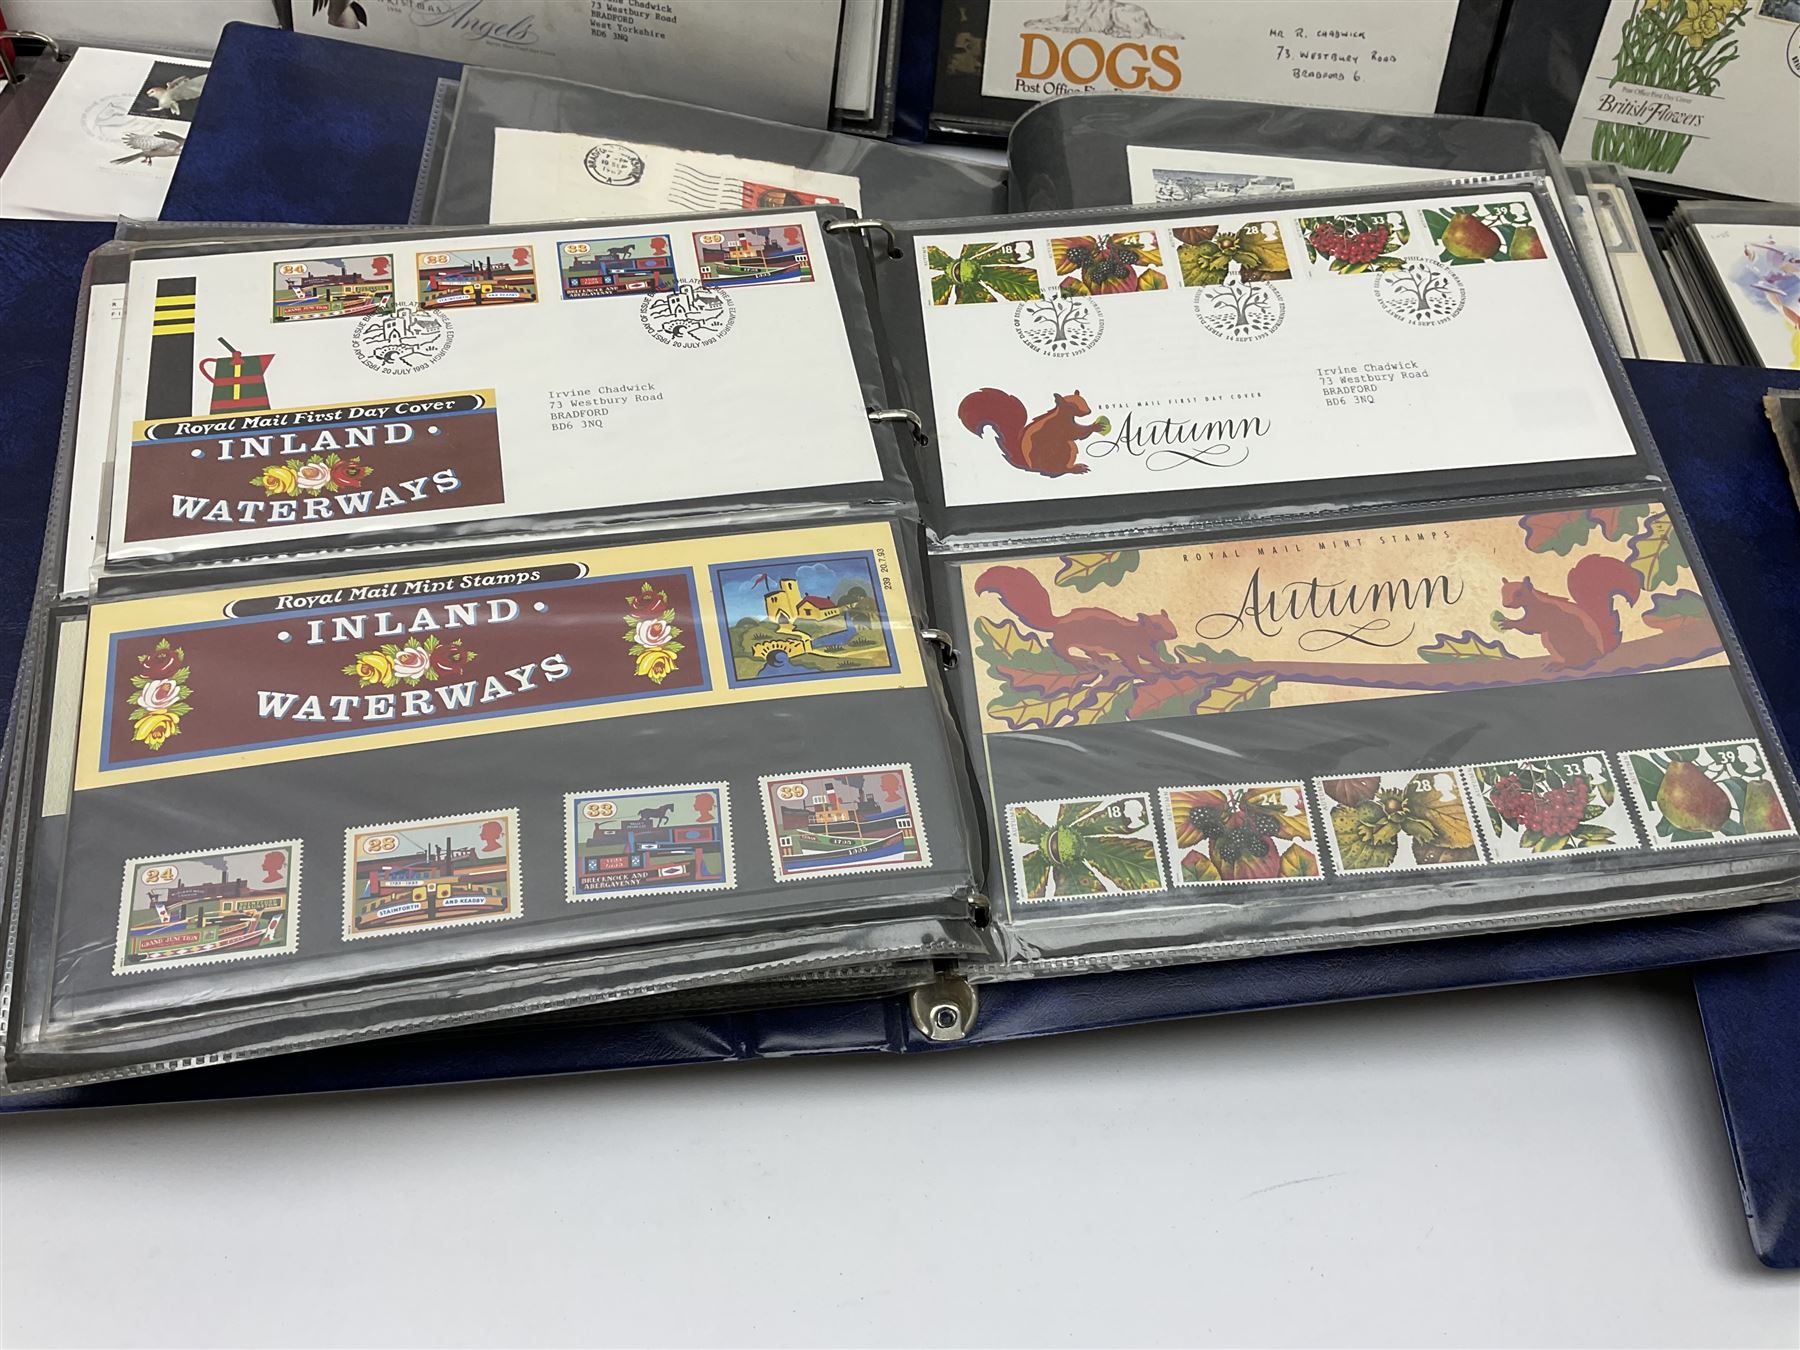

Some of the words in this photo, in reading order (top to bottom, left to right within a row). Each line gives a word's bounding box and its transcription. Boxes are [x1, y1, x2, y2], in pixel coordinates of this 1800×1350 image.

[591, 10, 634, 24] BRADFORD
[592, 1, 602, 9] 73
[606, 3, 650, 19] Westbury
[655, 13, 677, 24] Road
[590, 19, 612, 30] West
[617, 23, 666, 39] Yorkshire
[1016, 32, 1182, 93] DOGS
[1014, 78, 1041, 93] Post
[1597, 93, 1649, 118] British
[1638, 102, 1705, 127] Flowers
[1494, 206, 1508, 216] 39
[1372, 216, 1385, 225] 33
[1244, 226, 1259, 235] 28
[1124, 236, 1137, 246] 24
[1001, 245, 1012, 255] 18
[642, 323, 656, 334] DAY
[651, 332, 671, 345] FIRST
[354, 349, 366, 360] DAY
[361, 358, 381, 372] FIRST
[381, 367, 392, 375] 20
[392, 368, 412, 376] JULY
[1317, 365, 1358, 377] Irvine
[1363, 360, 1419, 373] Chadwick
[1319, 376, 1334, 386] 73
[1339, 372, 1395, 385] Westbury
[1400, 369, 1430, 380] Road
[548, 388, 592, 399] Irvine
[598, 382, 656, 395] Chadwick
[1322, 383, 1379, 396] BRADFORD
[549, 400, 563, 409] 73
[570, 396, 628, 408] Westbury
[634, 392, 664, 403] Road
[1098, 402, 1130, 410] ROYAL
[1168, 397, 1199, 405] FIRST
[1204, 394, 1224, 402] DAY
[1230, 392, 1263, 400] COVER
[1325, 396, 1347, 407] BD6
[1353, 394, 1376, 404] 3NQ
[174, 418, 237, 437] Royal
[241, 412, 290, 431] Mail
[293, 407, 343, 426] First
[347, 405, 390, 422] Day
[394, 398, 456, 415] Cover
[550, 407, 610, 421] BRADFORD
[551, 421, 574, 431] BD6
[581, 419, 604, 429] 3NQ
[217, 422, 415, 462] INLAND
[1086, 411, 1271, 460] Autumn
[170, 468, 462, 524] WATERWAYS
[1182, 549, 1241, 562] ROYAL
[1257, 544, 1302, 556] MAIL
[1318, 538, 1364, 550] MINT
[1379, 530, 1452, 545] STAMPS
[876, 547, 889, 573] 20.7.93
[275, 590, 343, 611] Royal
[347, 583, 401, 602] Mail
[403, 577, 455, 596] Mint
[460, 569, 542, 590] Stamps
[882, 577, 892, 590] 239
[1195, 566, 1465, 641] Autumn
[306, 598, 523, 645] INLAND
[256, 653, 573, 723] WATERWAYS
[1717, 751, 1736, 765] 39
[1563, 763, 1581, 777] 33
[779, 786, 805, 798] 39
[1412, 779, 1432, 793] 28
[1259, 793, 1278, 807] 24
[587, 803, 614, 817] 33
[1107, 805, 1122, 819] 18
[367, 837, 396, 853] 28
[146, 868, 175, 883] 24
[581, 873, 630, 885] BRECKNOCK
[631, 871, 649, 880] AND
[583, 879, 642, 890] ABERGAVENNY
[444, 898, 459, 906] AND
[459, 896, 486, 905] KEADBY
[379, 903, 420, 917] STAINFORTH
[140, 937, 163, 949] GRAND
[165, 934, 199, 944] JUNCTION
